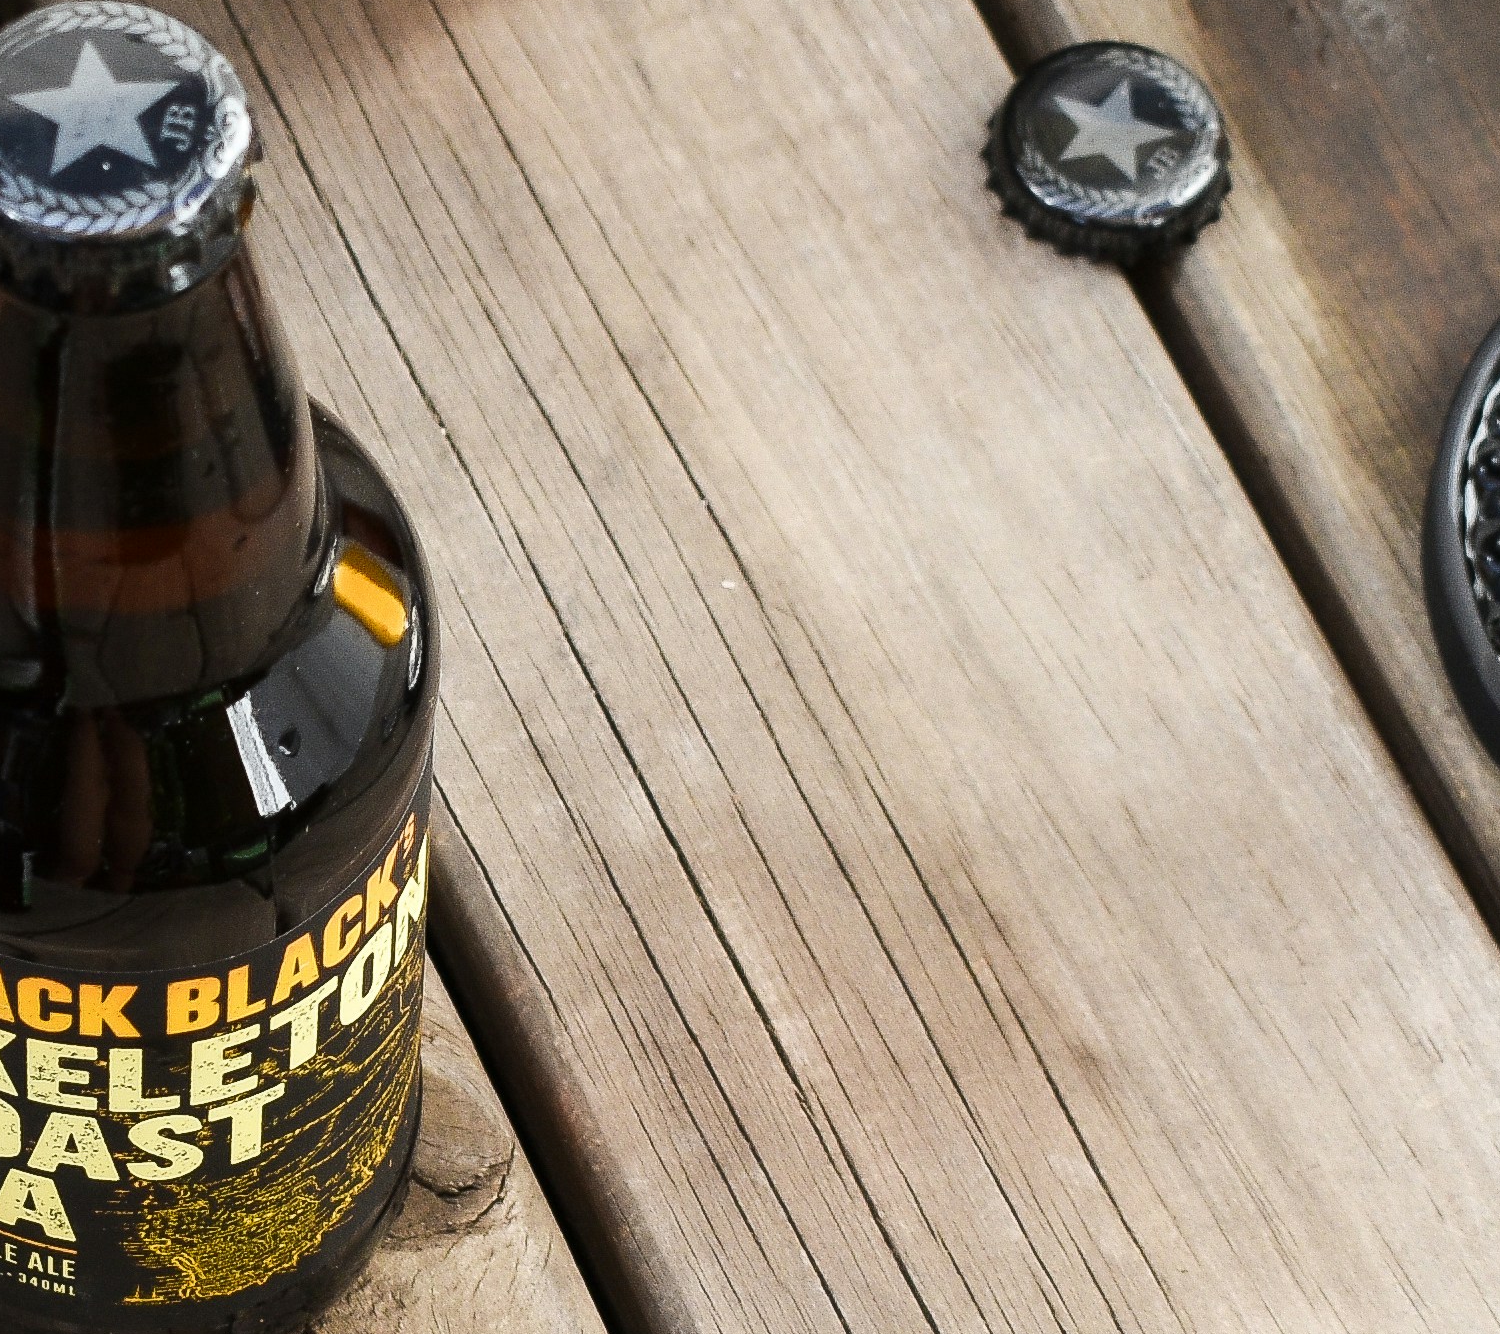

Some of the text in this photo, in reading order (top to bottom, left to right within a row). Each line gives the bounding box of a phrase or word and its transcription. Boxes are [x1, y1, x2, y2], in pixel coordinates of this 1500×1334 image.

[166, 811, 417, 1037] BLACK'S
[27, 1251, 76, 1280] ALE
[18, 1272, 76, 1297] 340ML
